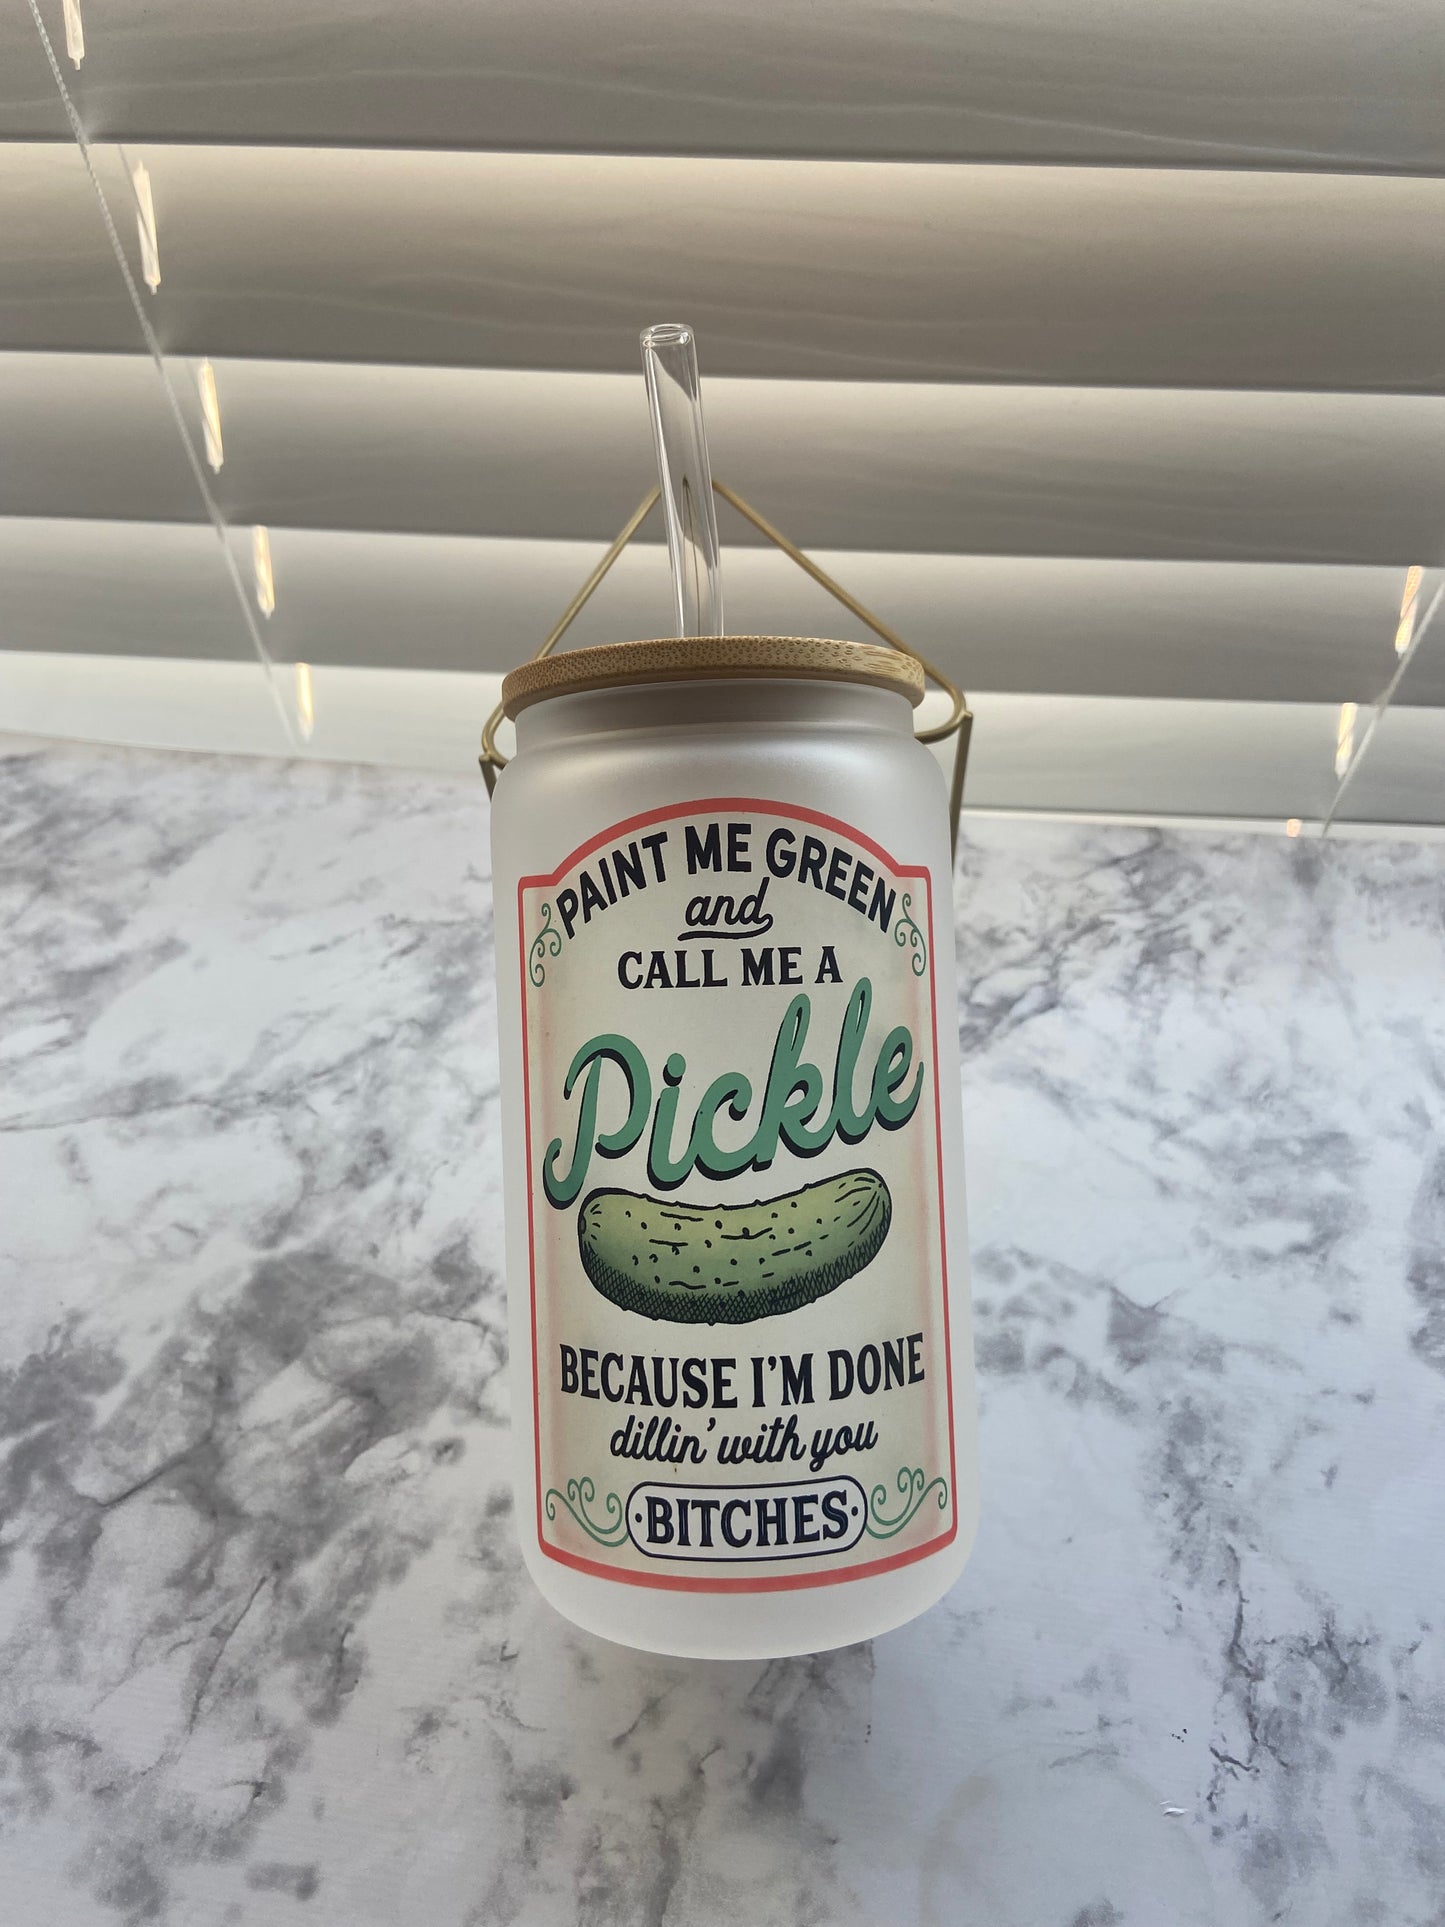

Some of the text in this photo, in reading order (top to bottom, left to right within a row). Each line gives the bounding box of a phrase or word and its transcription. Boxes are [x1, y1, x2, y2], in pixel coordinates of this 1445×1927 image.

[556, 823, 896, 939] PAINT ME GREEN
[678, 877, 773, 941] and
[618, 946, 843, 989] CALL ME A
[543, 977, 924, 1210] Pickle
[559, 1332, 925, 1408] BECAUSE I'M DONE
[610, 1414, 878, 1472] dillin' with you
[645, 1490, 850, 1547] BITCHES
